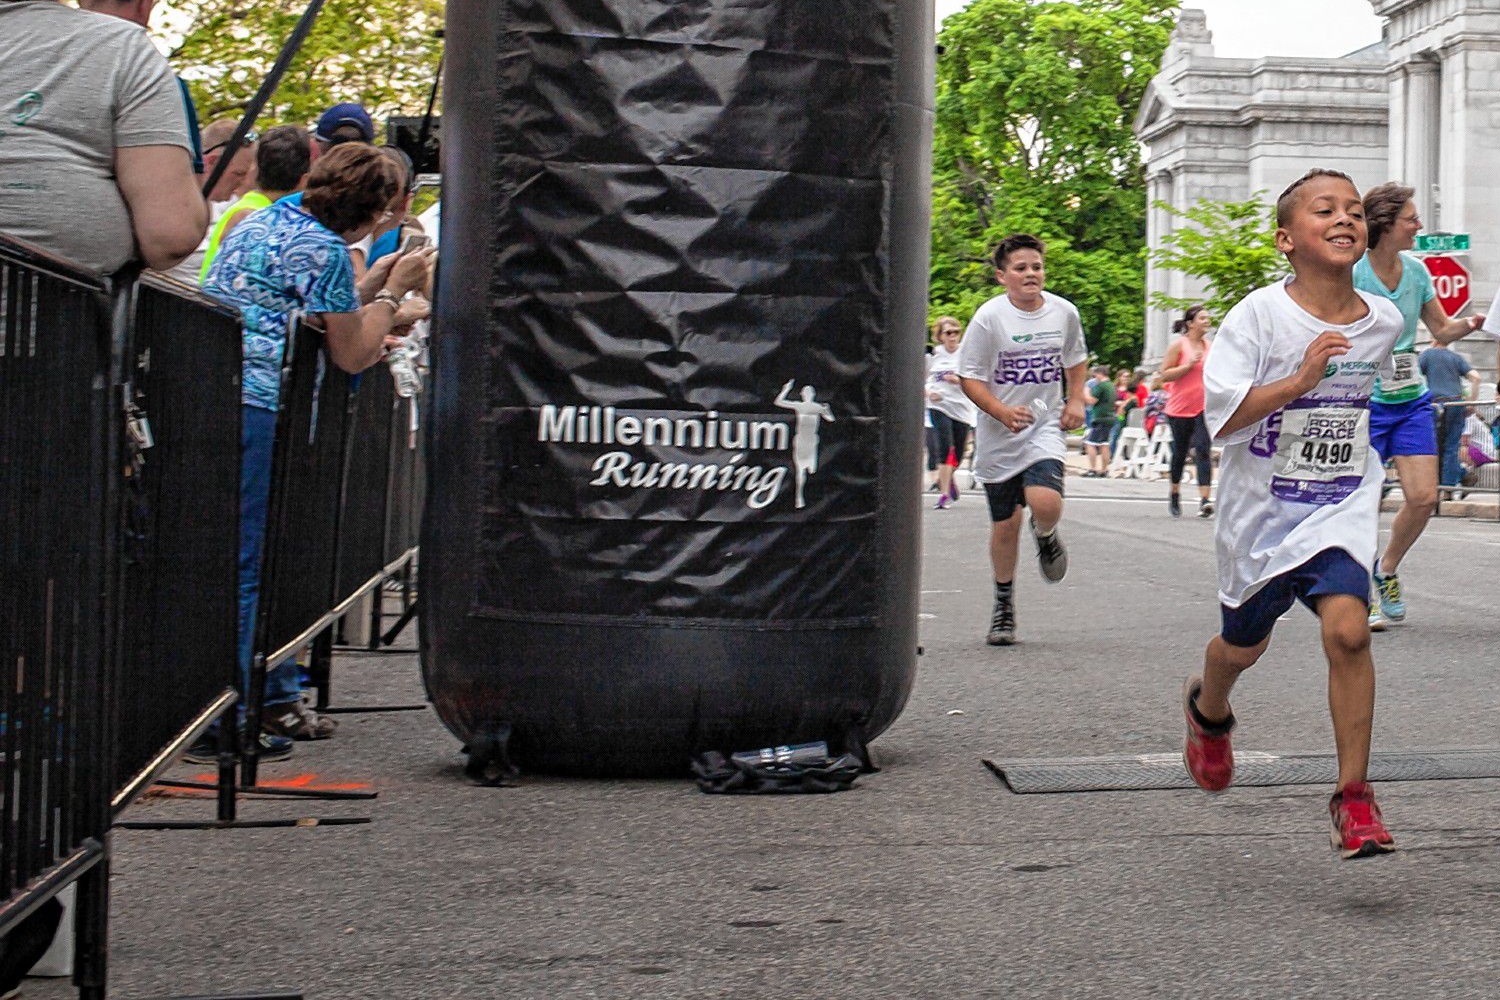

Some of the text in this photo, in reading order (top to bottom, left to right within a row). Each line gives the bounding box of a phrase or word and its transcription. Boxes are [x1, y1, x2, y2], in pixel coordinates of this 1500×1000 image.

[537, 404, 789, 451] Millennium
[1308, 428, 1356, 440] RACE
[1300, 441, 1354, 465] 4490
[589, 450, 789, 509] Running
